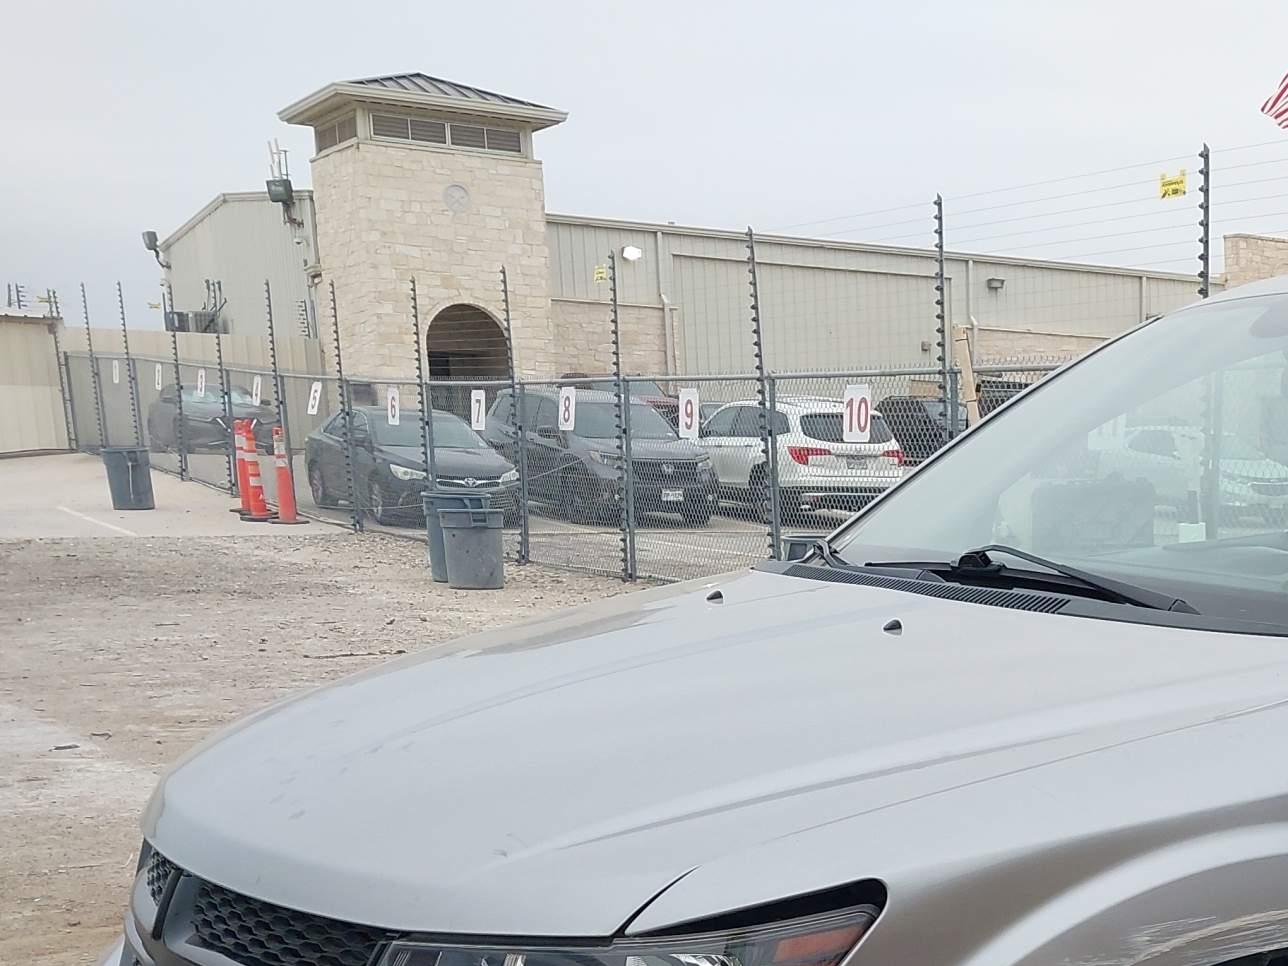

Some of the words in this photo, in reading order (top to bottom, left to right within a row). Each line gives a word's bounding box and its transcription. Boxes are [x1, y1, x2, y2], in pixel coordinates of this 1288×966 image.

[389, 395, 397, 419] 6
[475, 398, 482, 424] 7
[563, 395, 571, 423] 8
[684, 398, 694, 431] 9
[845, 396, 870, 433] 10
